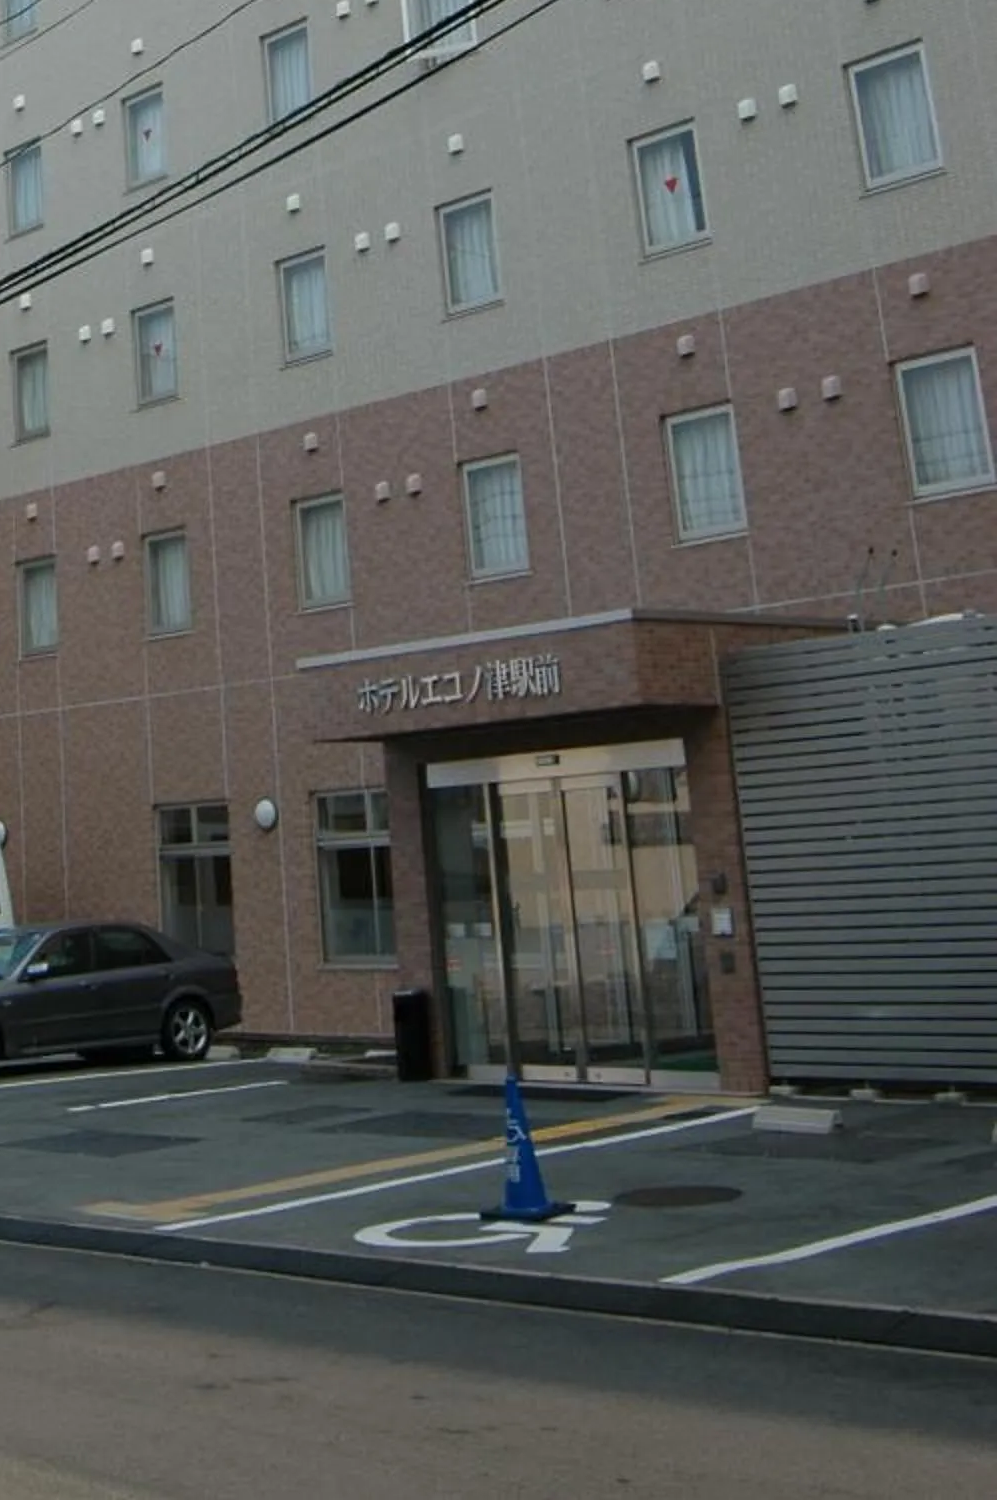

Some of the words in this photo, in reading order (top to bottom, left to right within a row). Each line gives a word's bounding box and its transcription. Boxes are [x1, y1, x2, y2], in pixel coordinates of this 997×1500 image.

[357, 654, 562, 714] ホテルエコノ津駅前
